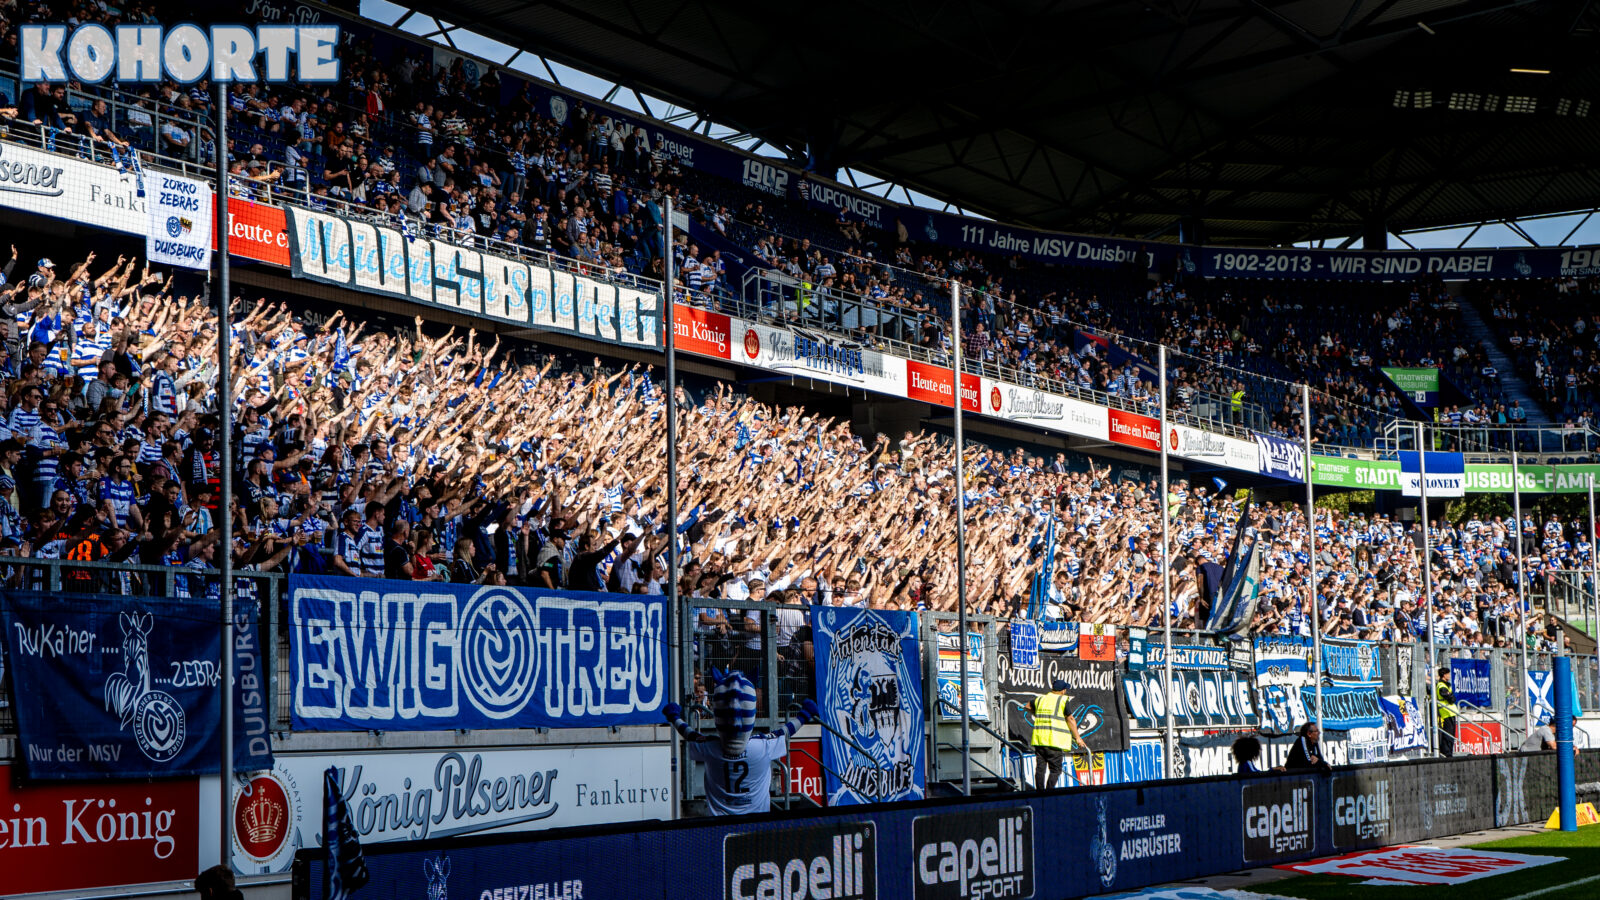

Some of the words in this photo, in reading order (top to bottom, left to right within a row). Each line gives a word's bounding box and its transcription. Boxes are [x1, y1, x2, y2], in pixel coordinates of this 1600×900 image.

[162, 177, 197, 195] ZORRO
[743, 159, 789, 191] 1902
[159, 192, 199, 212] ZEBRAS
[811, 183, 882, 222] KUPCONCEPT
[155, 240, 204, 261] DUISBURG
[962, 225, 984, 244] 111
[989, 231, 1030, 253] Jahre
[1033, 239, 1075, 258] MSV
[1213, 253, 1311, 273] 1902-2013
[1330, 256, 1366, 274] WIR
[1371, 257, 1421, 275] SIND
[1429, 256, 1493, 274] DABEI
[691, 321, 726, 353] König
[912, 371, 937, 394] Heute
[939, 379, 952, 395] ein
[961, 384, 978, 407] önig
[1396, 374, 1436, 382] STADTWERKE
[1416, 393, 1426, 401] 12
[1112, 418, 1132, 435] Heute
[1132, 424, 1142, 437] ein
[1142, 425, 1161, 447] König
[1318, 463, 1350, 474] STADTWERKE
[1318, 473, 1344, 482] DUISBURG
[1426, 478, 1461, 489] LONELY
[294, 587, 459, 720] EWIG
[535, 596, 664, 718] TREU
[236, 613, 269, 757] DUISBURG
[998, 654, 1045, 688] Proud
[1124, 678, 1255, 719] KOHORTE
[29, 744, 52, 761] Nur
[57, 744, 83, 762] der
[89, 744, 121, 762] MSV
[278, 763, 302, 822] LAUDATUR
[432, 752, 559, 826] Pilsener
[575, 780, 669, 807] Fankurve
[723, 761, 750, 794] 12
[1120, 814, 1166, 832] OFFIZIELLER
[1245, 787, 1308, 848] capelli
[1335, 780, 1390, 835] capelli
[61, 797, 176, 859] König
[1276, 834, 1308, 853] SPORT
[1362, 822, 1389, 840] SPORT
[919, 816, 1024, 897] capelli
[1120, 832, 1181, 861] AUSRÜSTER
[732, 832, 864, 900] capelli
[971, 875, 1024, 900] SPORT
